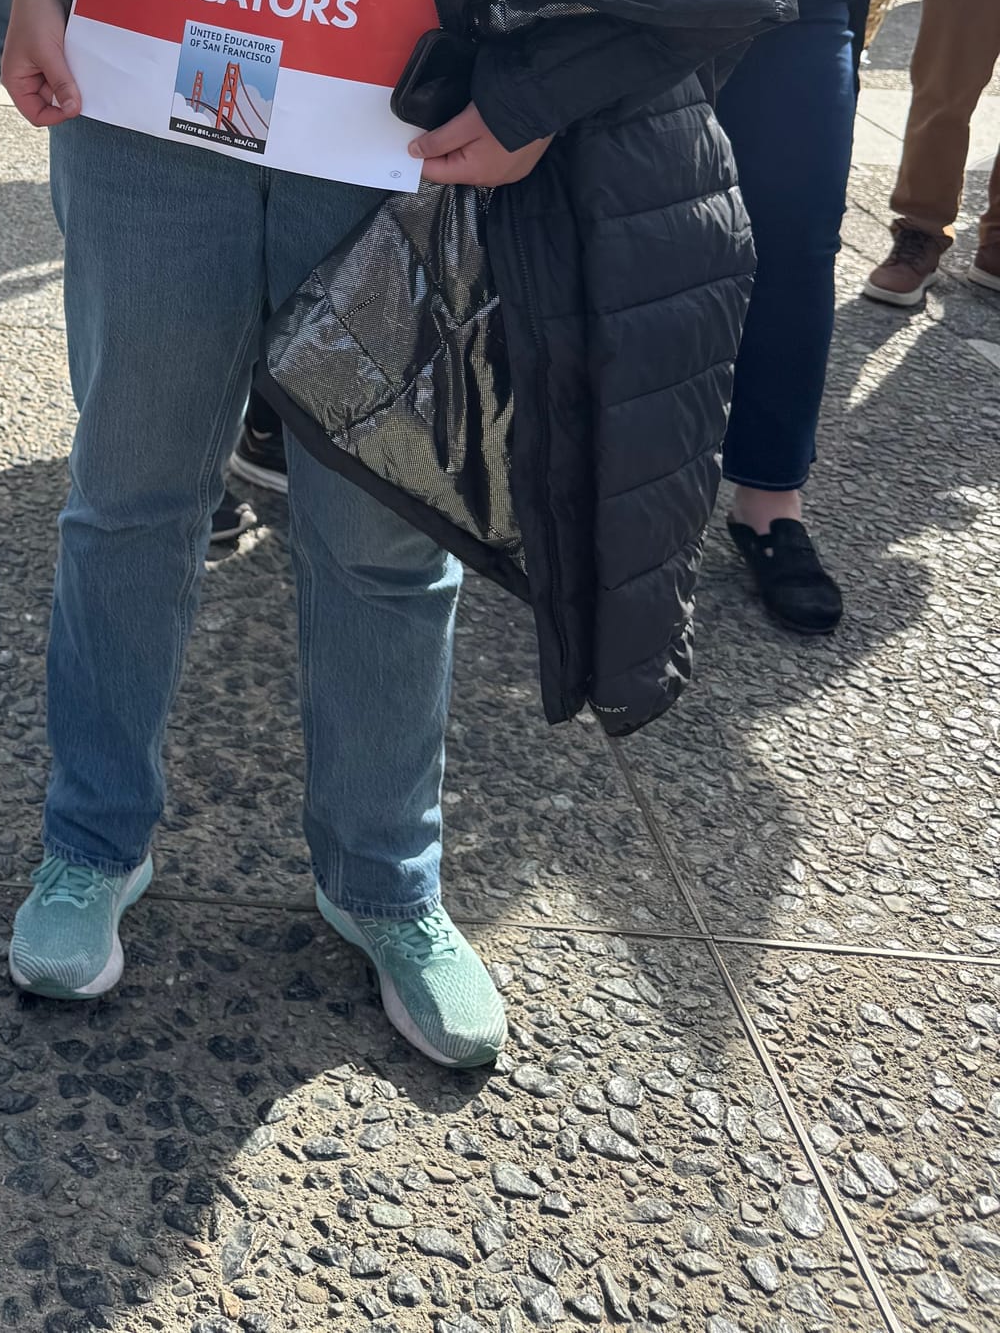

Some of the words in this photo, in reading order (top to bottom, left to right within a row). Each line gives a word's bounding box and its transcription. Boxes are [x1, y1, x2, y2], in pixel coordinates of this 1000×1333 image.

[190, 25, 222, 42] UNITED
[224, 32, 277, 54] EDUCATORS
[203, 39, 220, 53] SAN
[222, 44, 272, 65] FRANCISCO
